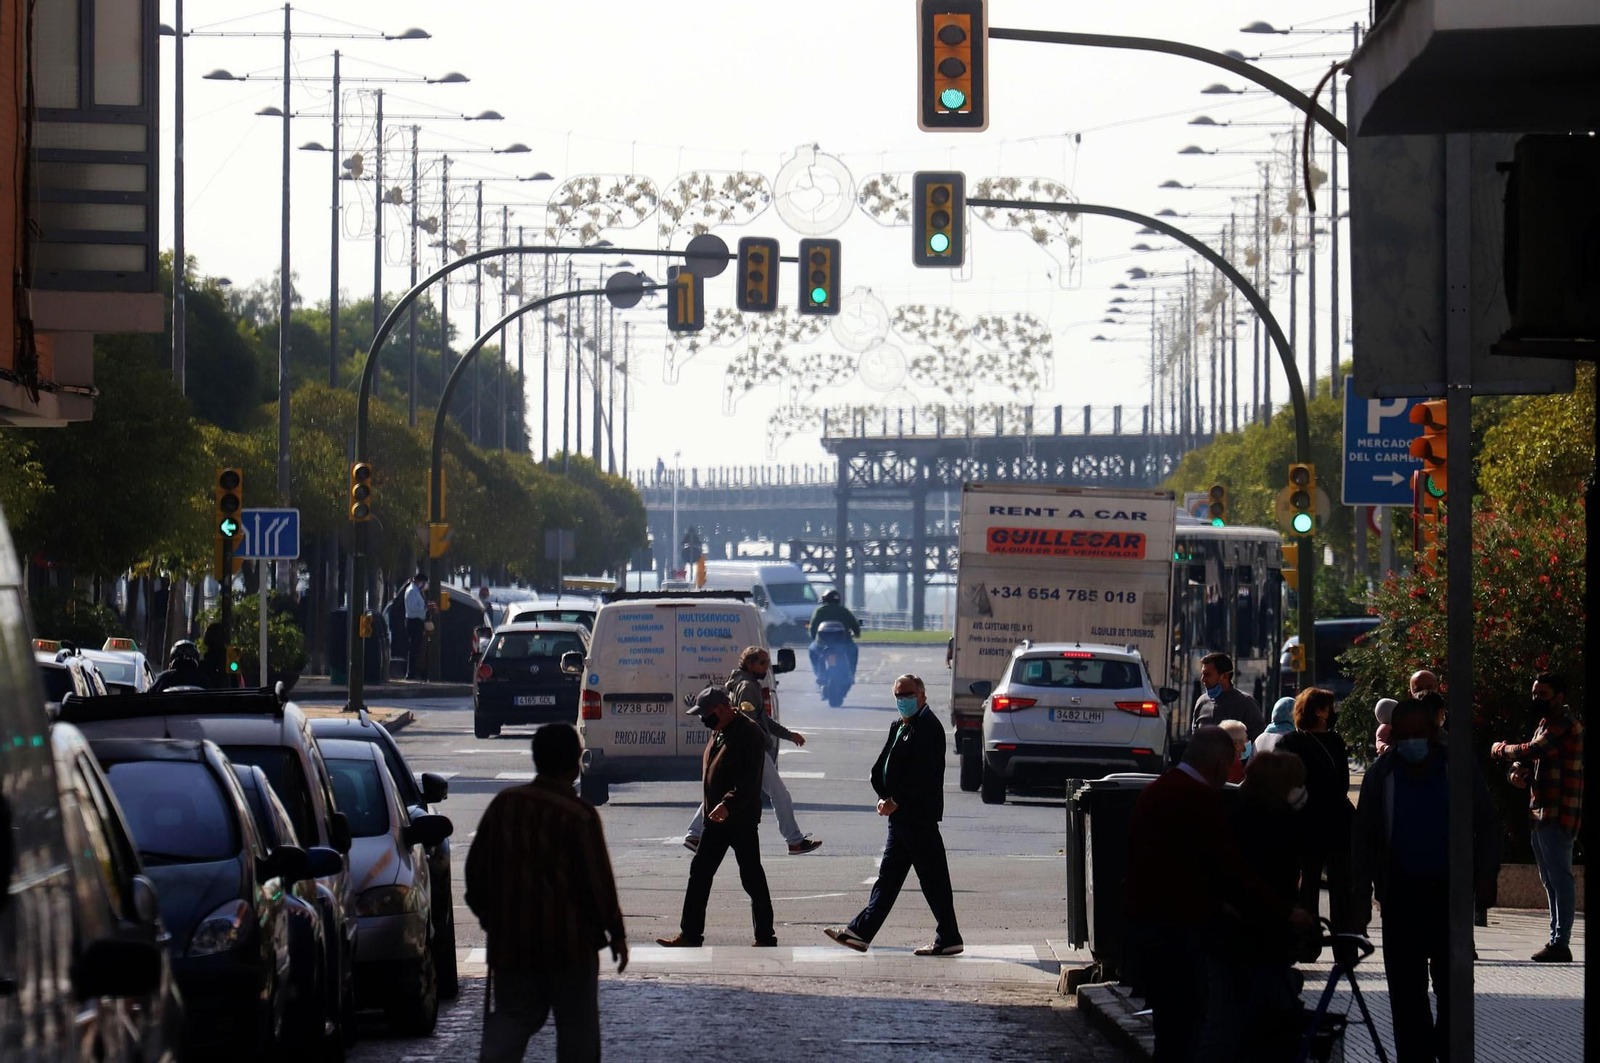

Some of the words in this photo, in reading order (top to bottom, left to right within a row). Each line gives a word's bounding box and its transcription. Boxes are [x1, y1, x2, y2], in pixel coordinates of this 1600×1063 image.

[1349, 452, 1370, 462] DEL
[989, 505, 1059, 518] RENT
[1068, 509, 1085, 519] A
[1094, 510, 1147, 521] CAR
[991, 529, 1141, 549] GUILLECAR
[993, 546, 1051, 555] ALQUILER
[1054, 548, 1069, 556] DE
[1073, 549, 1139, 558] VEHICULOS
[990, 586, 1022, 599] +34
[1027, 588, 1061, 601] 654
[1066, 589, 1099, 602] 785
[1104, 590, 1137, 604] 018
[678, 613, 740, 623] MULTISERVICIOS
[684, 628, 694, 638] EN
[697, 628, 731, 638] GENERAL
[1091, 627, 1117, 636] ALQUILER
[1117, 628, 1125, 637] DE
[617, 703, 642, 714] 2738
[646, 703, 665, 713] GJD
[1056, 710, 1080, 720] 3482
[1083, 711, 1101, 720] LHH
[614, 731, 638, 745] BRICO
[639, 731, 666, 745] HOGAR
